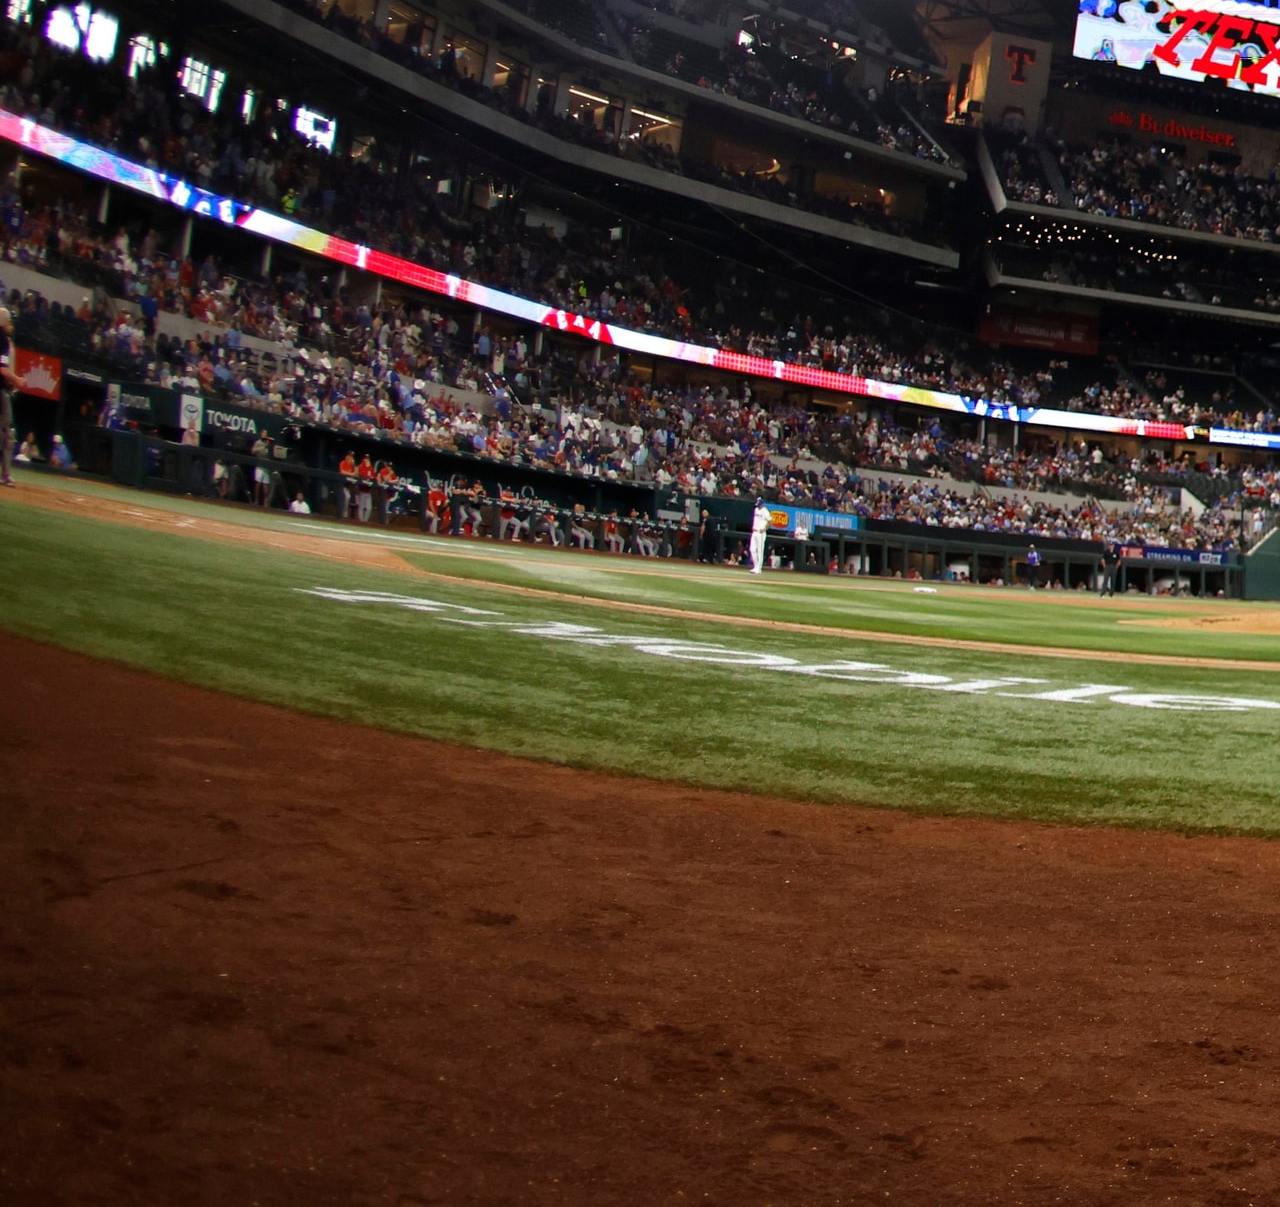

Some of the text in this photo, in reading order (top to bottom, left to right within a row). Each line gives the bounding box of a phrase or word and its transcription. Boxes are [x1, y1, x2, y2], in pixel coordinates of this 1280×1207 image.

[1006, 45, 1036, 84] T
[206, 409, 257, 434] TOYOTA
[1146, 551, 1181, 562] STREAMING
